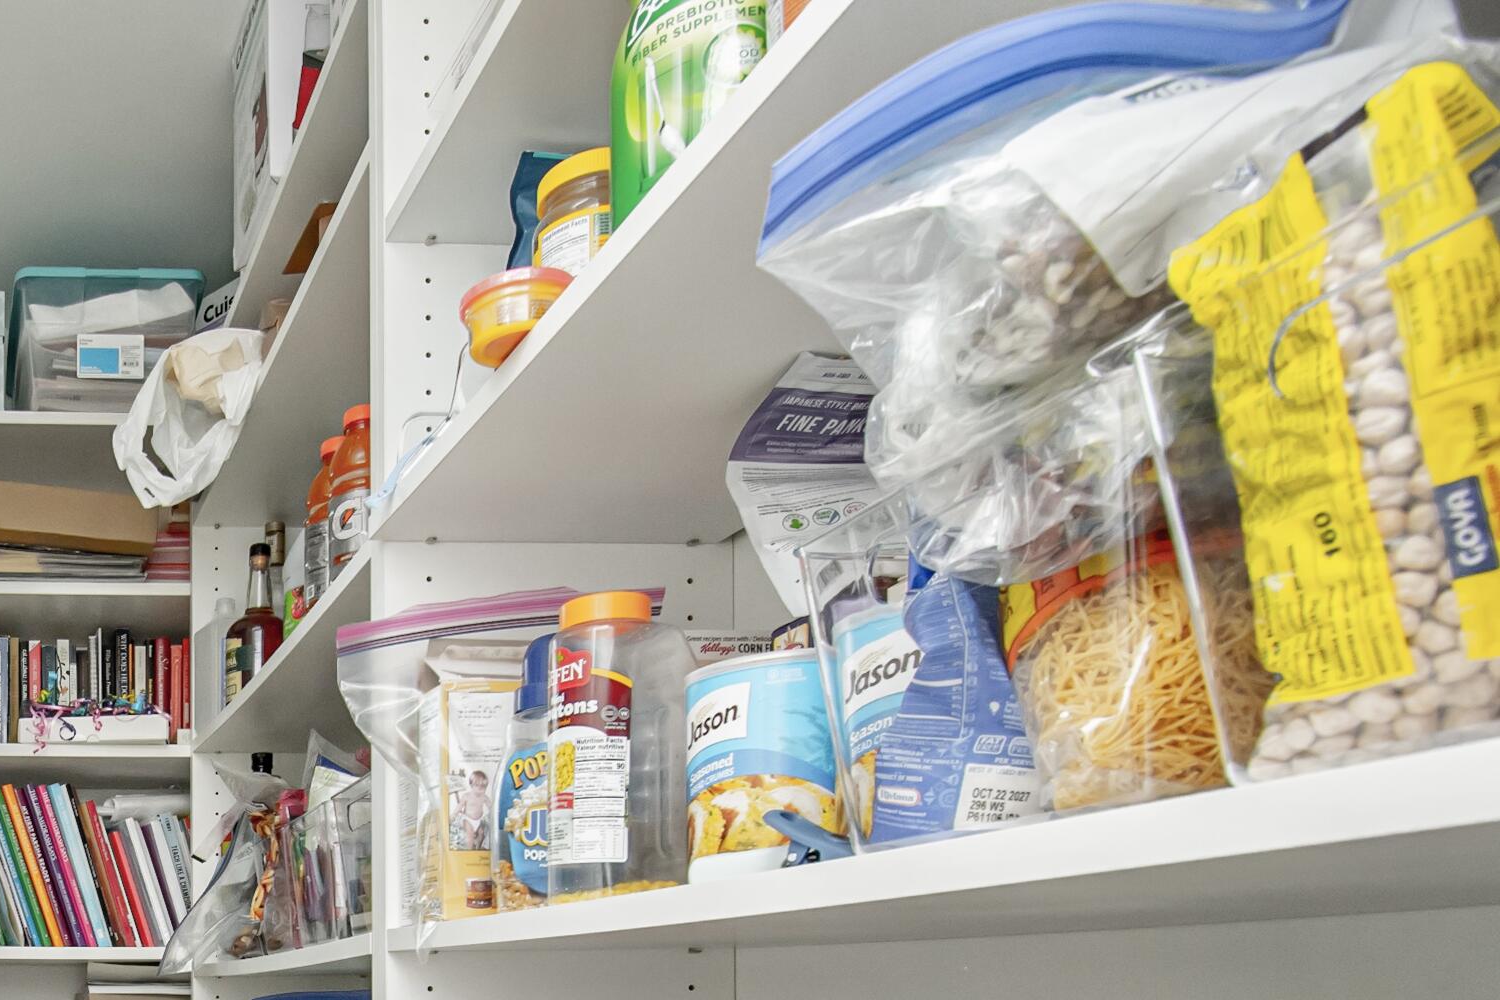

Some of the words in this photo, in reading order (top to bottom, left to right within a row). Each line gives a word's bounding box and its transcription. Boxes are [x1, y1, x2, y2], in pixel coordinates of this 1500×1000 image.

[632, 34, 668, 67] FIBER
[673, 5, 767, 39] SUPPLEMEN
[783, 396, 824, 409] JAPANESE
[825, 400, 852, 410] STYLE
[776, 413, 823, 433] FINE
[820, 418, 867, 435] PANK
[331, 495, 367, 541] G
[1447, 488, 1489, 566] GOYA
[1313, 511, 1343, 558] 160
[120, 633, 128, 651] WHY
[700, 643, 736, 656] Kellogg's
[738, 643, 763, 653] CORN
[846, 649, 921, 704] Jason
[688, 704, 738, 750] Jason
[851, 716, 894, 744] Season
[598, 743, 624, 751] nutritive
[1009, 790, 1031, 802] 2027
[171, 845, 181, 863] TEACH
[37, 858, 50, 883] READER
